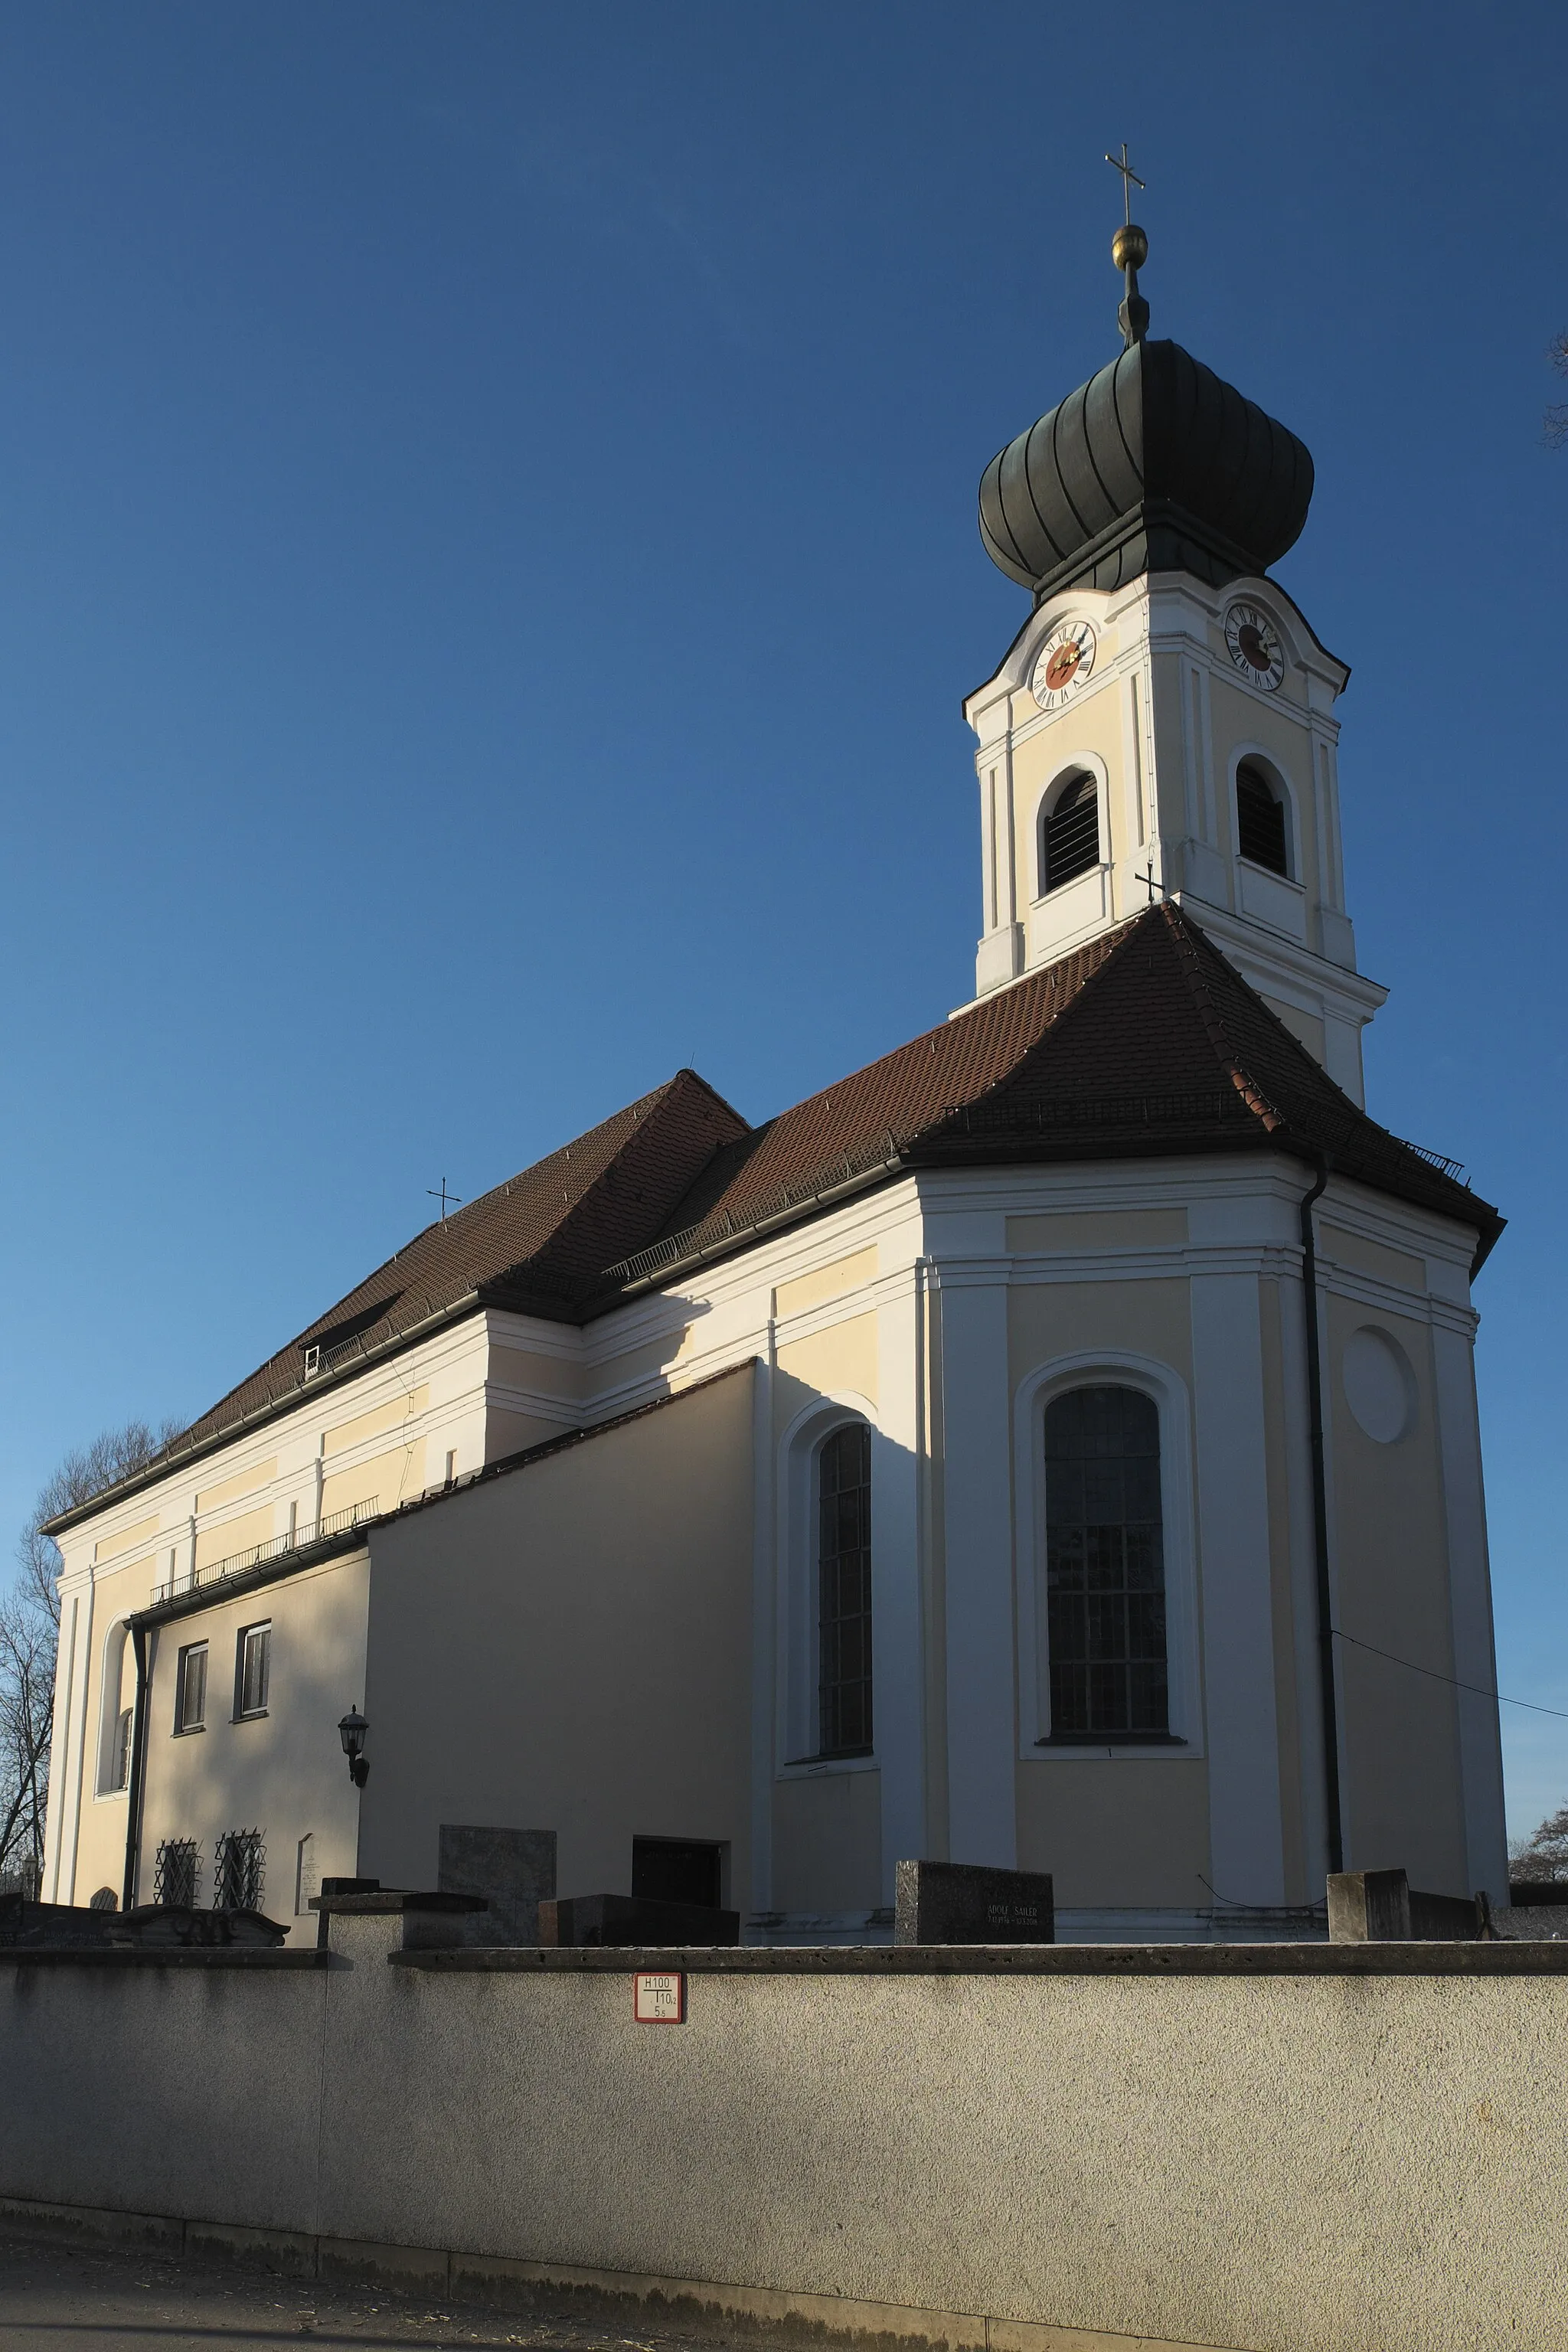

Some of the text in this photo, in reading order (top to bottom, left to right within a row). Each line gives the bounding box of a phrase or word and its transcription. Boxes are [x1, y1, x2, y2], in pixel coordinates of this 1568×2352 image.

[988, 1904, 1037, 1916] ADOLF SAILER
[660, 1993, 677, 2005] 10,2
